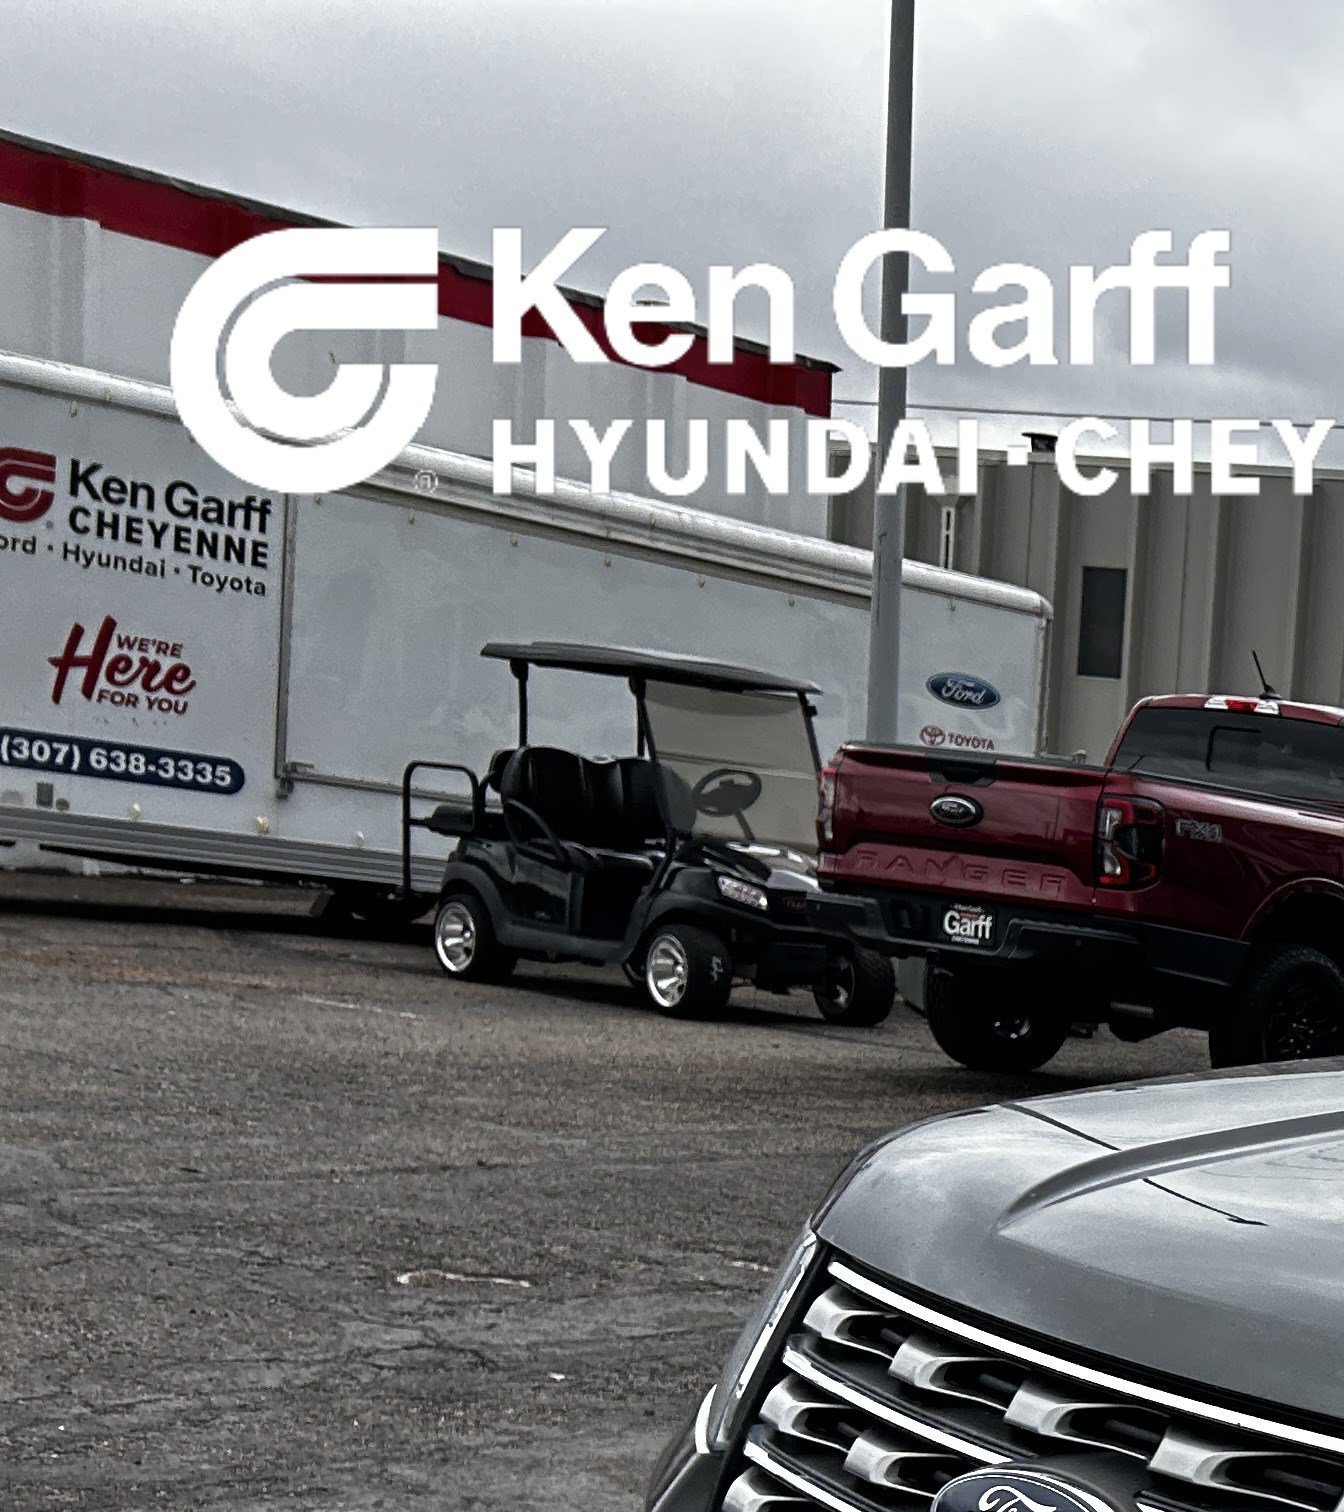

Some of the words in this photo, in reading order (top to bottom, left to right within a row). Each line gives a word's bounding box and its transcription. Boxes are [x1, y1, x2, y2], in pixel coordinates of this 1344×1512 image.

[68, 458, 155, 512] Ken
[165, 479, 272, 534] Garff
[68, 505, 269, 569] CHEYENNE
[63, 541, 166, 579] Hyundai
[188, 563, 267, 596] Toyota
[48, 615, 196, 705] Here
[116, 633, 183, 659] WE'RE
[96, 689, 139, 709] FOR
[146, 696, 189, 716] YOU
[1, 734, 81, 771] (307)
[89, 749, 232, 787] 638-3335
[947, 732, 995, 751] TOYOTA
[855, 849, 1068, 900] RANGER
[943, 909, 993, 940] Garff
